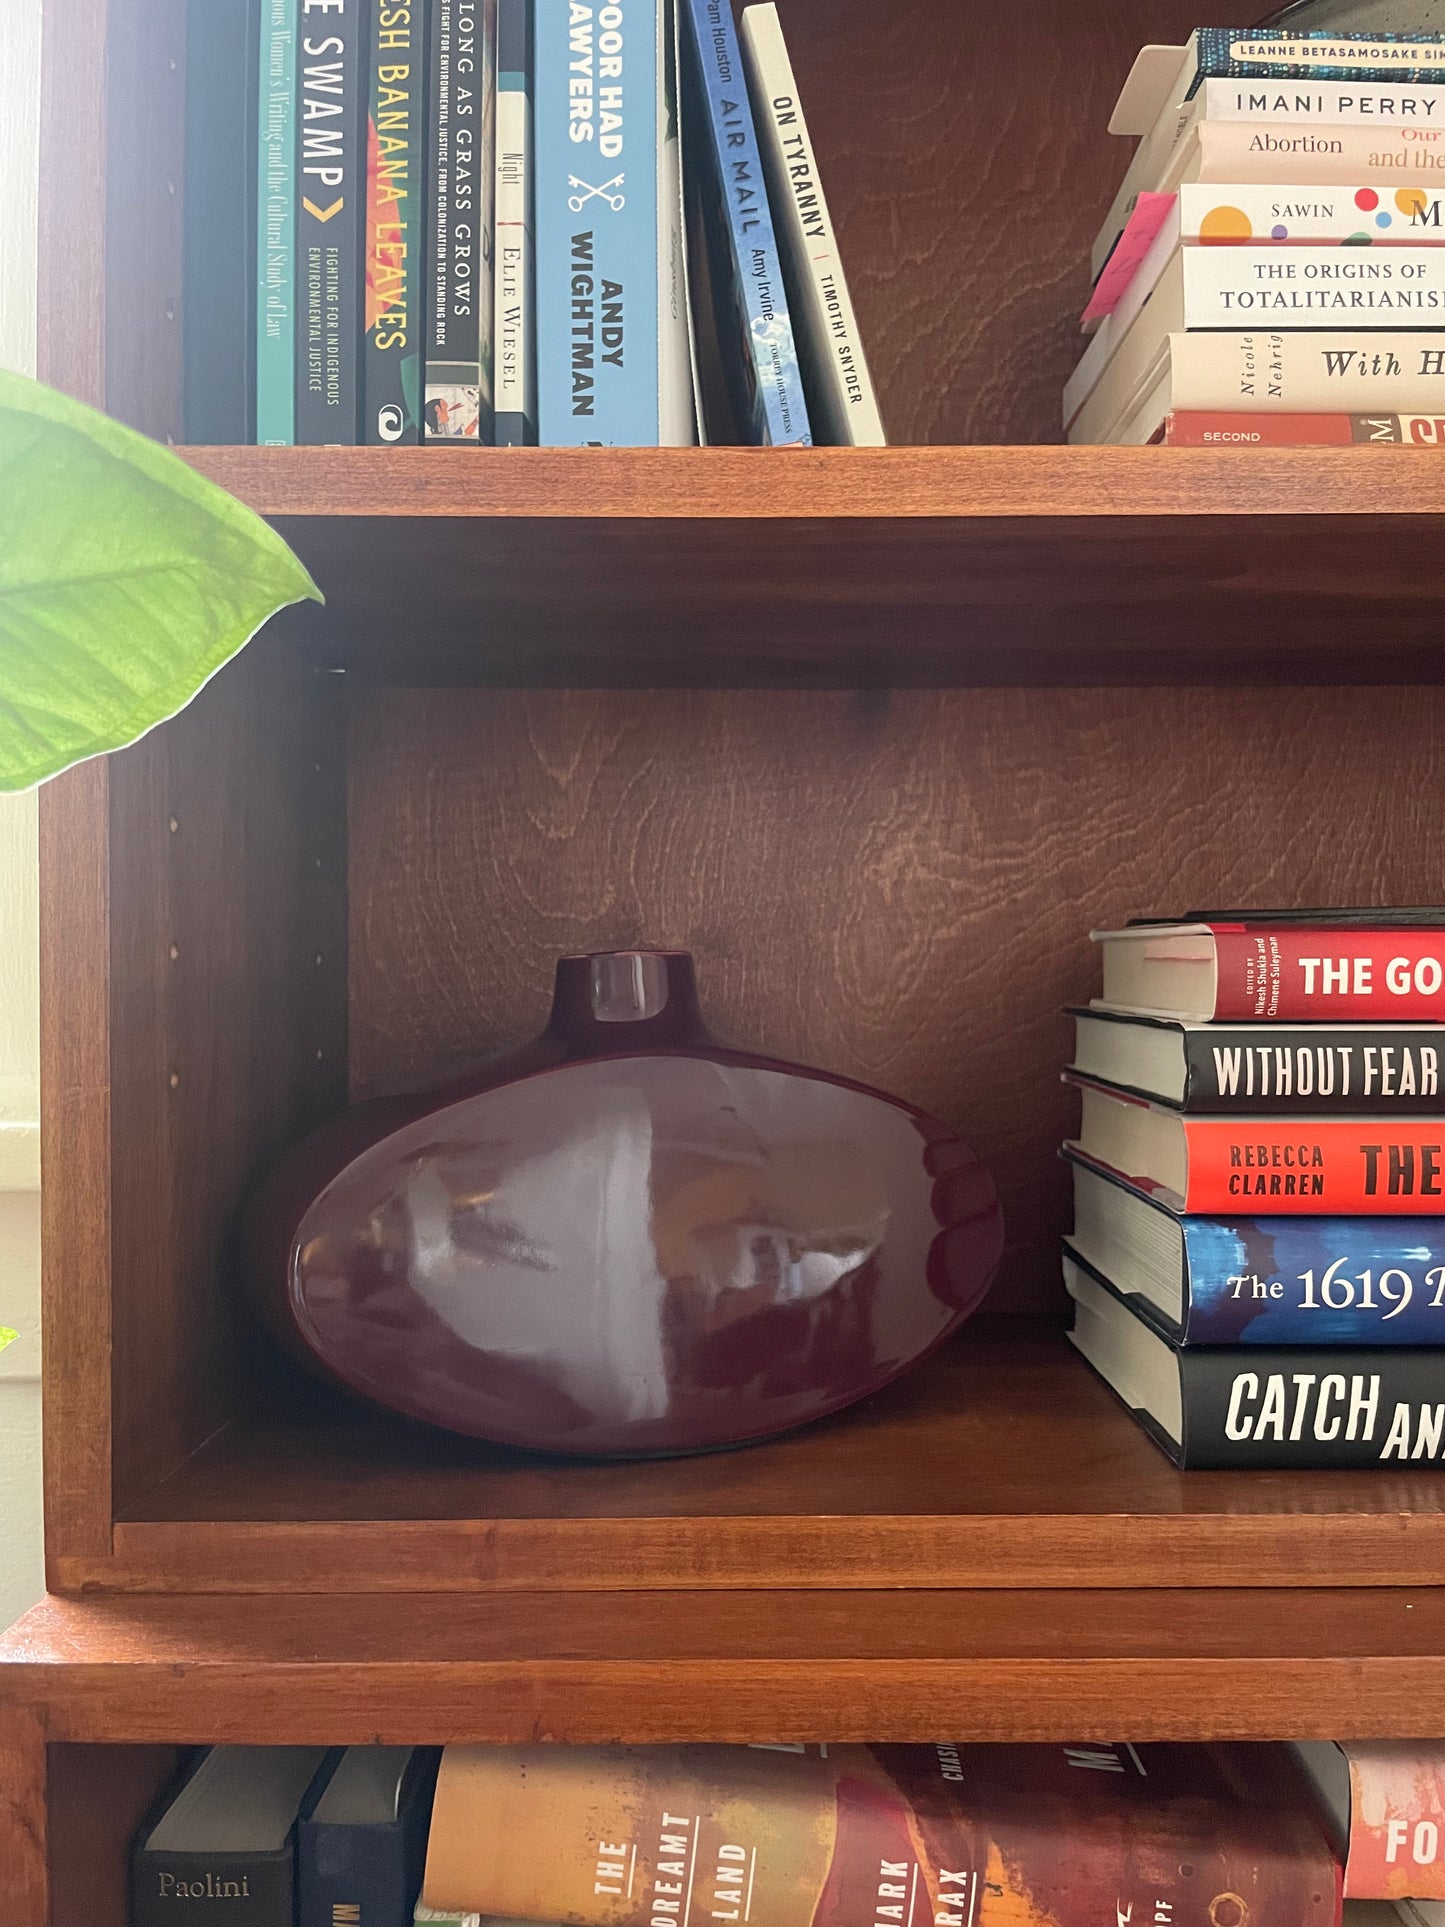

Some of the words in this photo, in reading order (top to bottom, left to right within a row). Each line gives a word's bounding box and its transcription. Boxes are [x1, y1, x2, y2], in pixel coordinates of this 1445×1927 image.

[441, 7, 450, 31] FIGHT
[458, 3, 474, 74] LONG
[440, 34, 450, 51] FOR
[598, 0, 622, 78] OOR
[712, 28, 732, 83] Houston
[1240, 45, 1296, 56] LEANNE
[1302, 47, 1418, 59] BETASAMOSAKE
[439, 55, 449, 125] ENVIRONMENTAL
[569, 0, 594, 143] AWYERS
[263, 92, 290, 142] Writing
[303, 37, 344, 186] SWAMP
[457, 87, 473, 115] AS
[773, 96, 797, 126] ON
[1237, 94, 1323, 112] IMANI
[1338, 97, 1437, 116] PERRY
[376, 64, 409, 207] BANANA
[599, 86, 623, 158] HAD
[721, 99, 745, 150] AIR
[1401, 128, 1441, 142] Our
[268, 144, 289, 168] and
[1249, 133, 1343, 154] Abortion
[1368, 148, 1408, 168] and
[1415, 149, 1445, 169] the
[268, 172, 289, 192] the
[438, 168, 447, 193] FROM
[456, 130, 473, 210] GRASS
[497, 153, 524, 184] Night
[783, 134, 826, 237] TYRANNY
[731, 161, 760, 234] MAIL
[1271, 203, 1335, 218] SAWIN
[267, 196, 289, 249] Cultural
[437, 196, 447, 259] COLONIZATION
[260, 254, 288, 292] Study
[326, 248, 339, 302] FIGHTING
[437, 262, 447, 273] TO
[454, 224, 471, 316] GROWS
[751, 249, 767, 278] Amy
[1254, 264, 1297, 279] THE
[1304, 264, 1393, 279] ORIGINS
[1400, 264, 1428, 279] OF
[267, 296, 288, 311] of
[308, 247, 321, 342] ENVIRONMENTAL
[375, 222, 407, 350] LEAVES
[436, 276, 446, 319] STANDING
[757, 282, 774, 322] Irvine
[1220, 290, 1445, 309] TOTALITARIANIS
[266, 314, 288, 339] Law
[327, 307, 339, 329] FOR
[435, 322, 446, 345] ROCK
[571, 231, 594, 416] WIGHTMAN
[601, 279, 624, 368] ANDY
[769, 342, 784, 376] TORREY
[820, 275, 848, 339] TIMOTHY
[838, 346, 863, 404] SNYDER
[309, 347, 322, 391] JUSTICE
[327, 334, 340, 405] INDIGENOUS
[1240, 337, 1255, 396] Nicole
[1268, 335, 1283, 398] Nehrig
[1321, 351, 1402, 377] With
[776, 377, 788, 408] HOUSE
[781, 408, 792, 434] PRESS
[1203, 432, 1261, 442] SECOND
[1246, 957, 1254, 967] BY
[1254, 937, 1265, 958] and
[1268, 936, 1282, 983] Suleyman
[1246, 968, 1254, 995] EDITED
[1255, 959, 1267, 990] Shukla
[1298, 958, 1373, 995] THE
[1385, 957, 1443, 996] GO
[1254, 991, 1267, 1015] Nikesh
[1267, 984, 1280, 1017] Chimene
[1213, 1047, 1353, 1096] WITHOUT
[1363, 1047, 1439, 1096] FEAR
[1230, 1145, 1324, 1167] REBECCA
[1359, 1145, 1442, 1195] THE
[1229, 1174, 1325, 1195] CLARREN
[1226, 1274, 1284, 1299] The
[1297, 1256, 1414, 1320] 1619
[1225, 1372, 1380, 1441] CATCH
[1379, 1403, 1445, 1459] AN
[936, 1741, 965, 1781] CHASI
[1385, 1819, 1445, 1865] FO
[159, 1872, 250, 1897] Paolini
[594, 1841, 627, 1894] THE
[650, 1812, 690, 1927] DREAMT
[711, 1844, 746, 1919] LAND
[874, 1859, 908, 1927] ARK
[1154, 1900, 1173, 1927] PF
